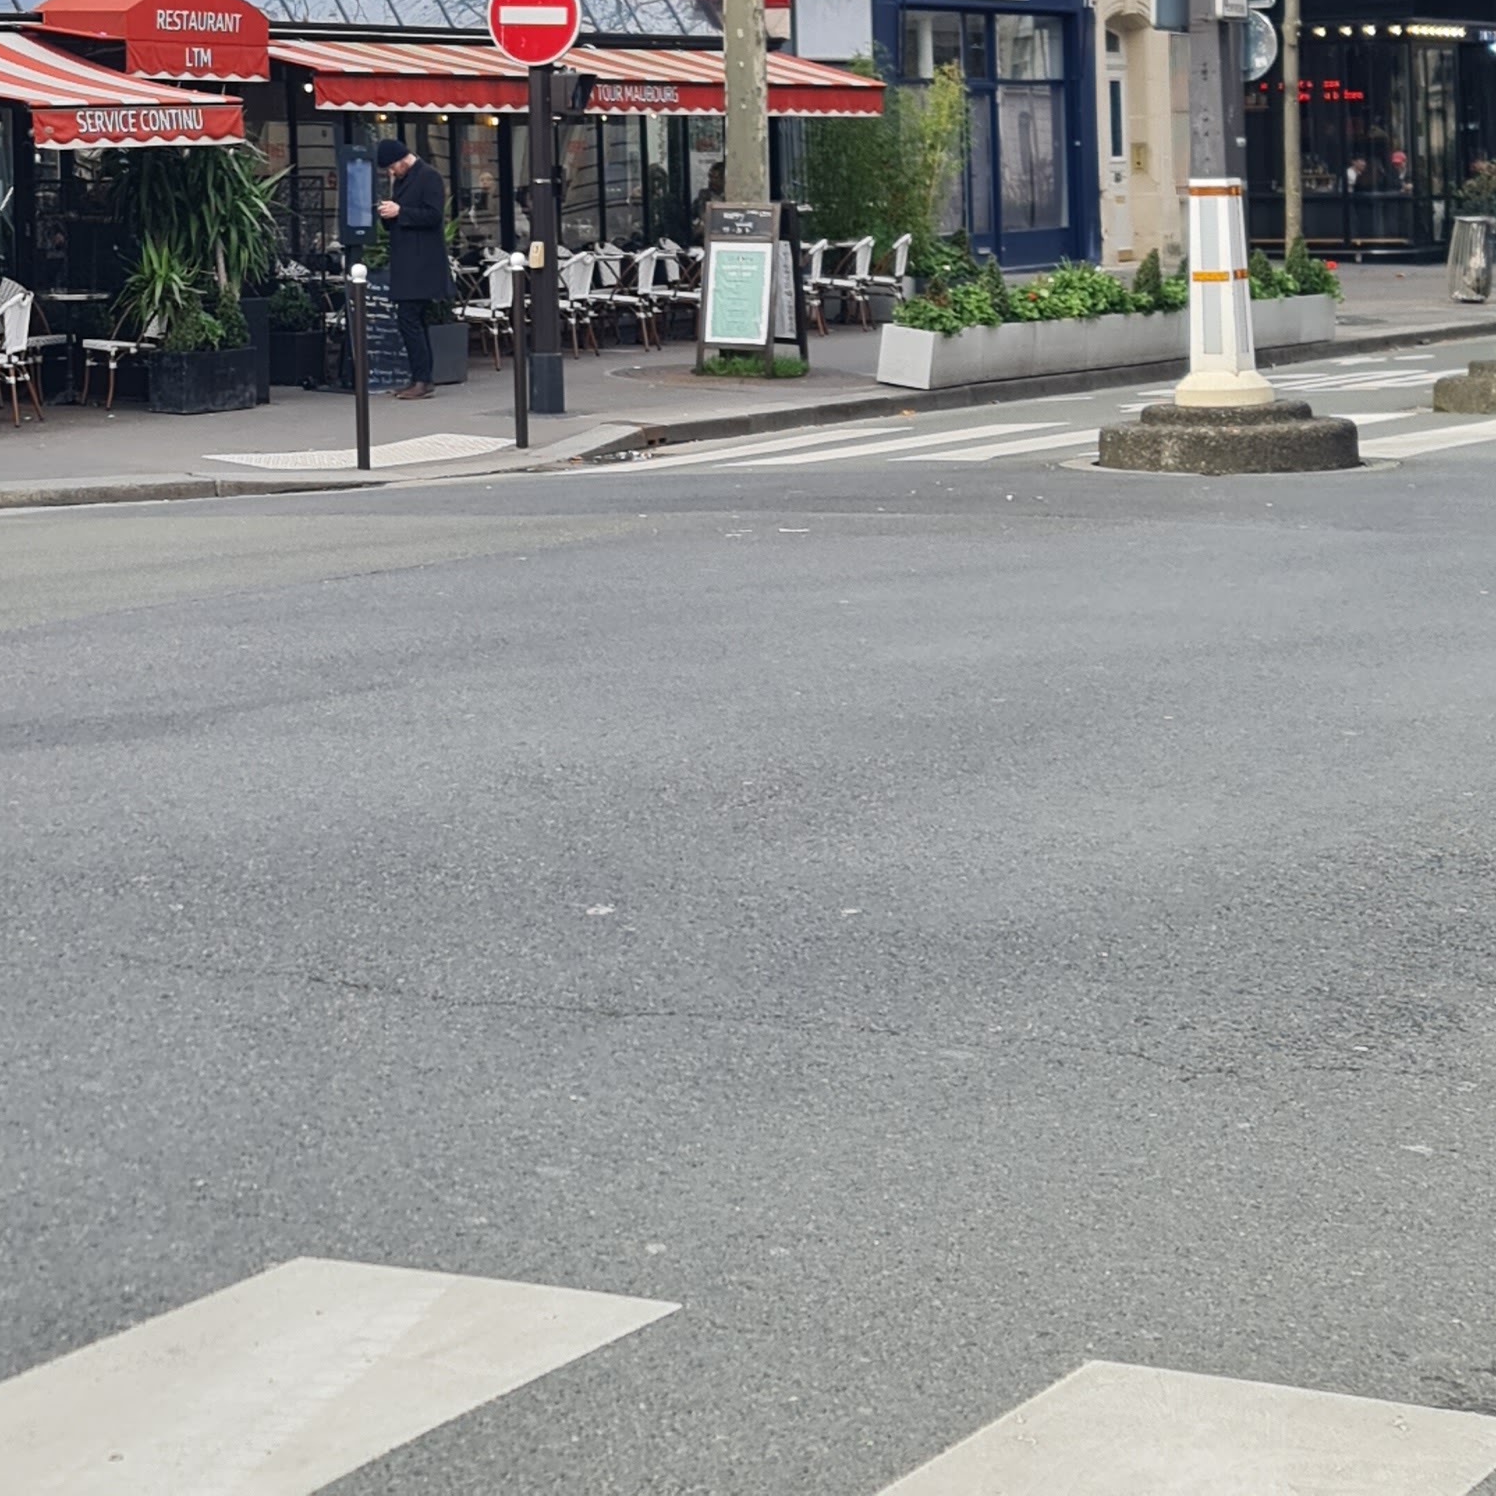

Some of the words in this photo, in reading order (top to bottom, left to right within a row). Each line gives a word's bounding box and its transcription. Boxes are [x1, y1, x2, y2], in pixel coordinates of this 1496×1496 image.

[157, 9, 243, 34] RESTAURANT
[185, 46, 212, 69] LTM
[596, 84, 623, 102] TOUR
[624, 85, 680, 103] MAUBOURG
[76, 110, 136, 134] SERVICE
[140, 109, 203, 132] CONTINU
